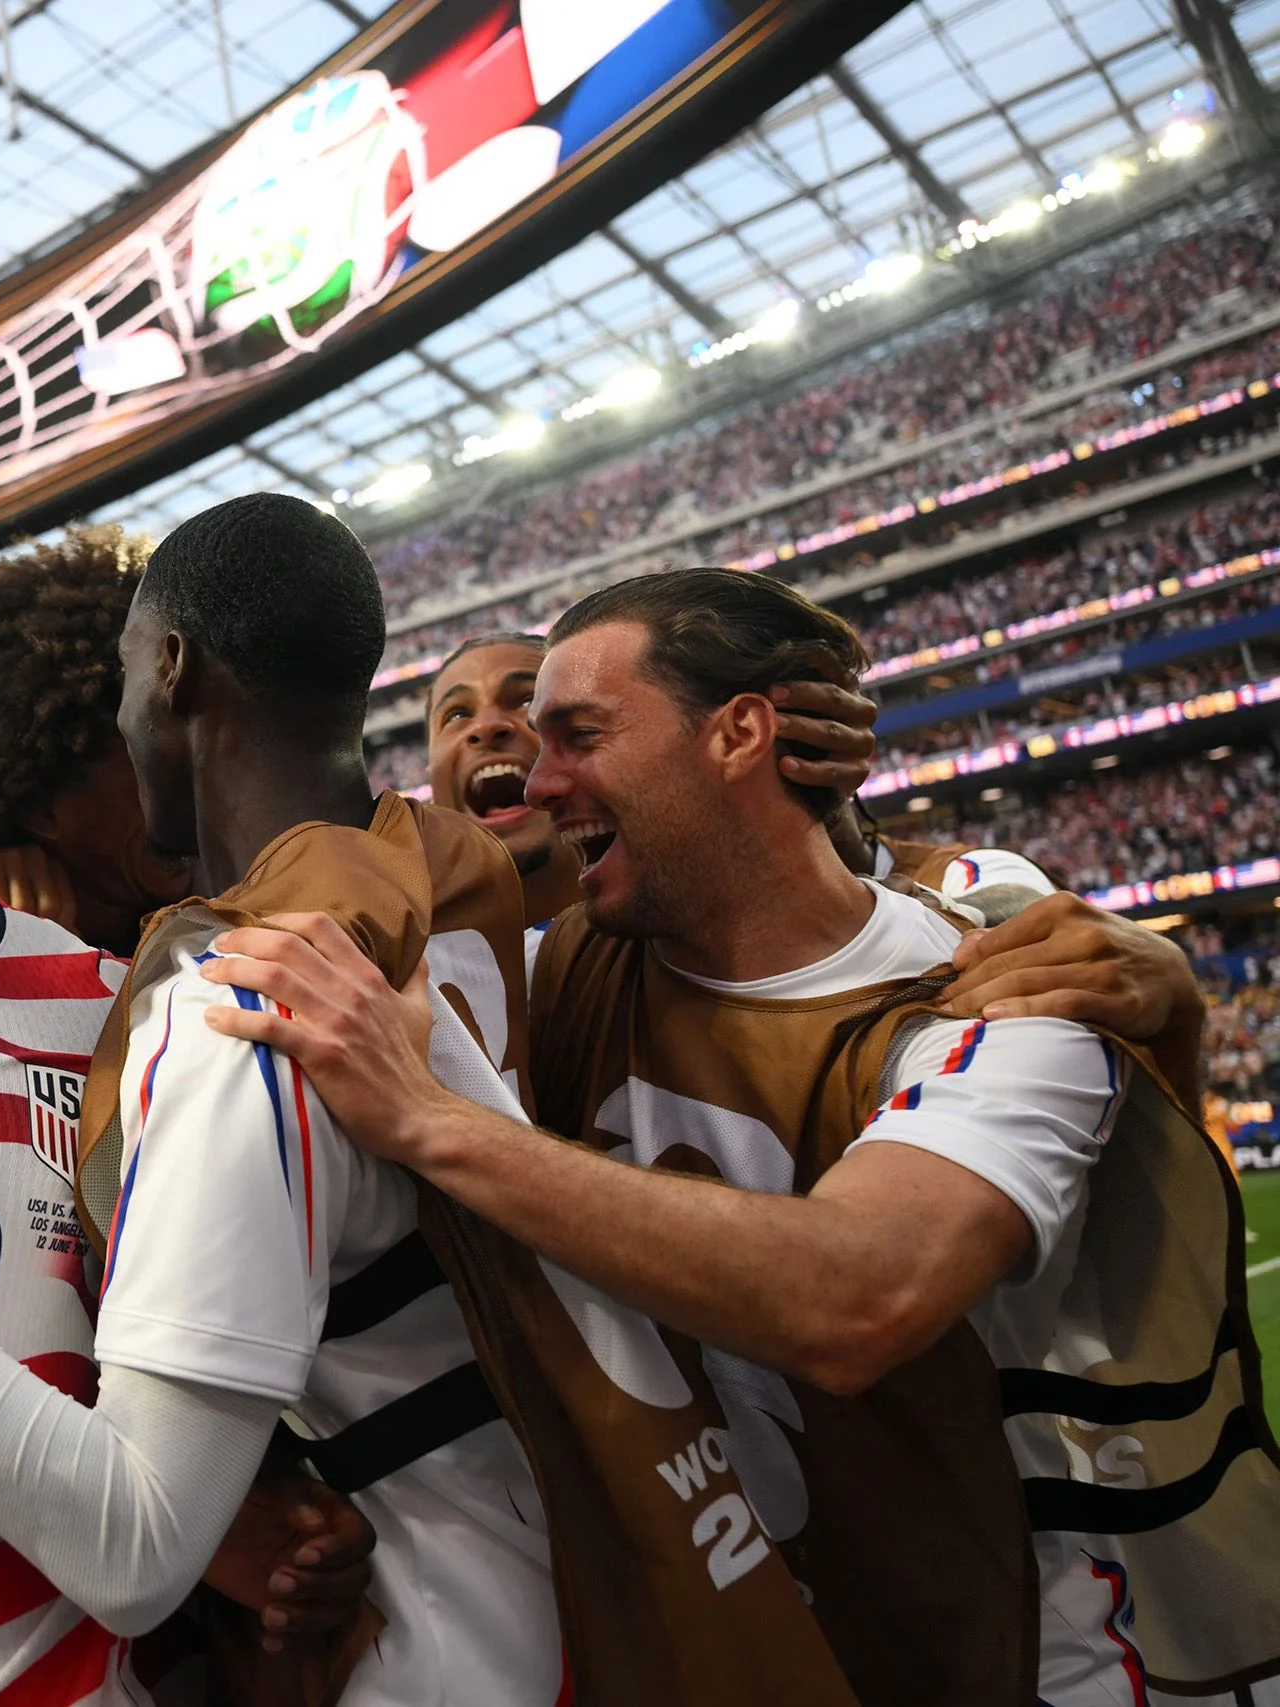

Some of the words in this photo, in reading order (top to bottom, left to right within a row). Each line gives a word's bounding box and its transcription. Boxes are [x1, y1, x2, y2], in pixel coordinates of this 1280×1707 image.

[33, 1069, 87, 1121] US
[27, 1198, 48, 1214] USA
[51, 1203, 65, 1218] VS.
[30, 1216, 50, 1231] LOS
[51, 1220, 86, 1239] ANGELE
[36, 1234, 47, 1249] 12
[48, 1237, 73, 1253] JUNE
[655, 1426, 729, 1502] WO
[691, 1493, 771, 1591] 2
